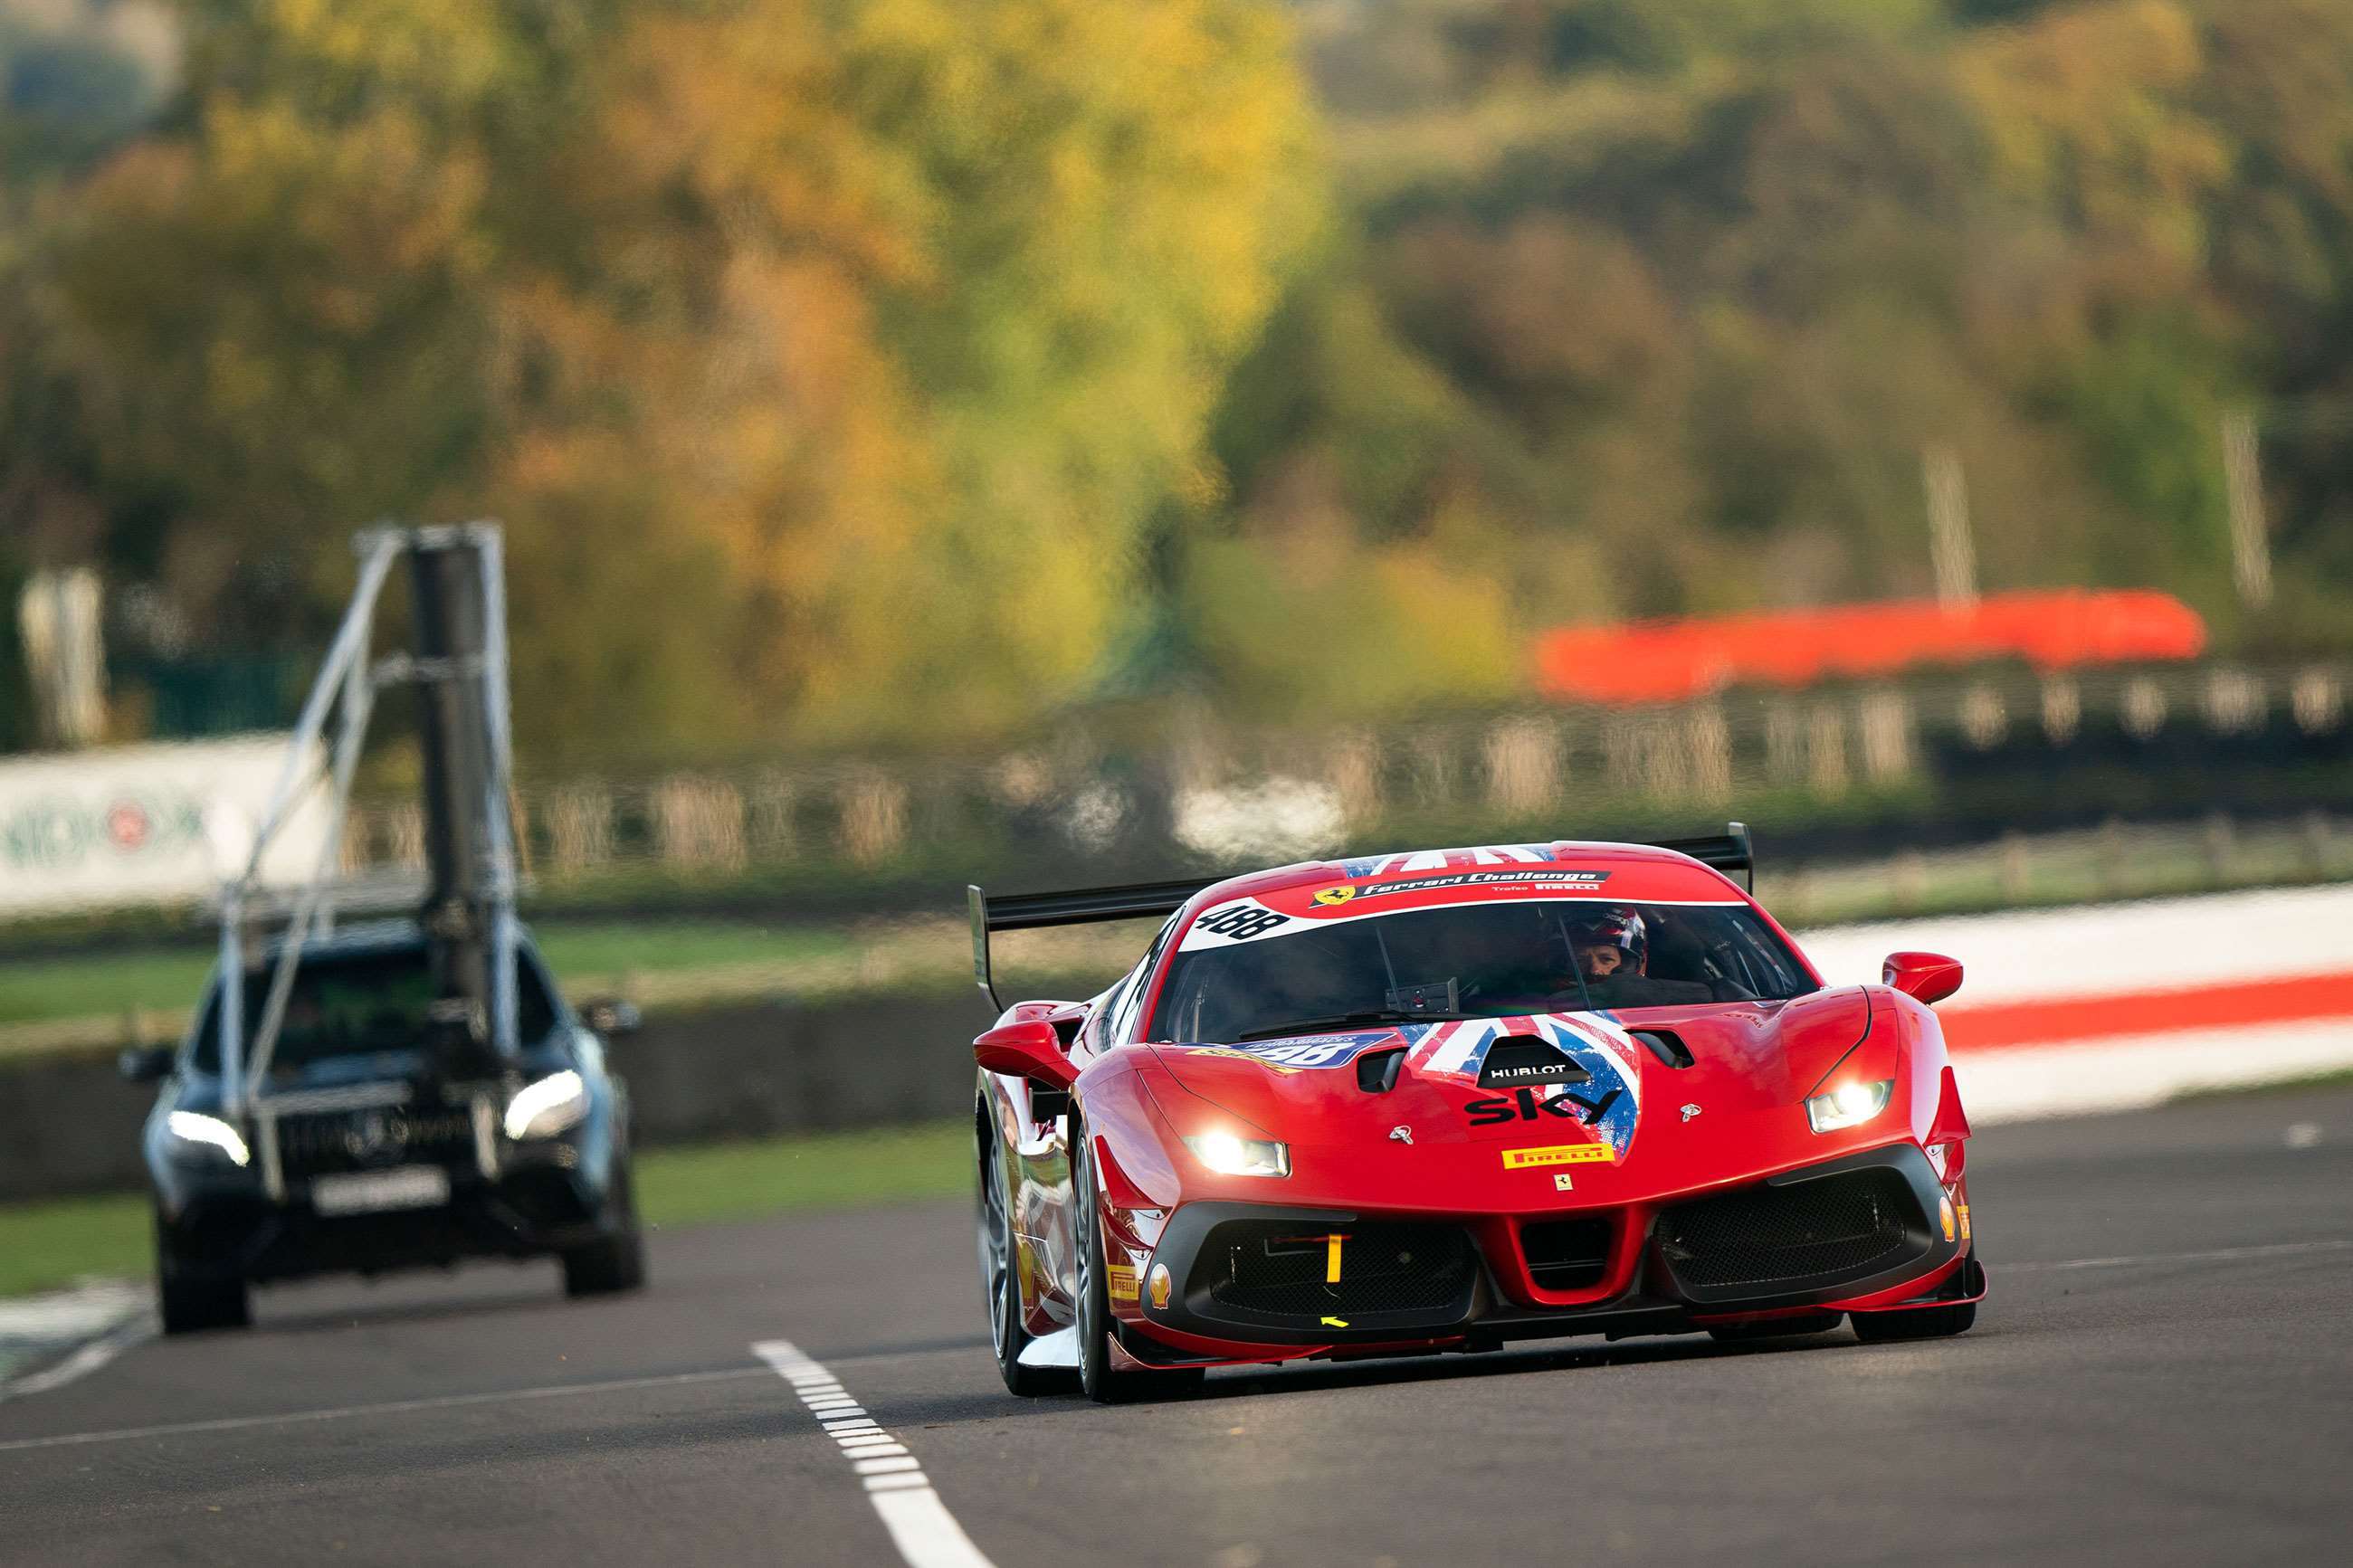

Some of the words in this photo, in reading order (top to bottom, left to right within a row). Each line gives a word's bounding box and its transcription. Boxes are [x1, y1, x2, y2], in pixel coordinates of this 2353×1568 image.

[1364, 876, 1463, 895] Ferrari
[1468, 872, 1596, 883] Challenge
[1196, 905, 1291, 940] 488
[1491, 1065, 1566, 1078] HUBLOT
[1464, 1088, 1623, 1126] sky
